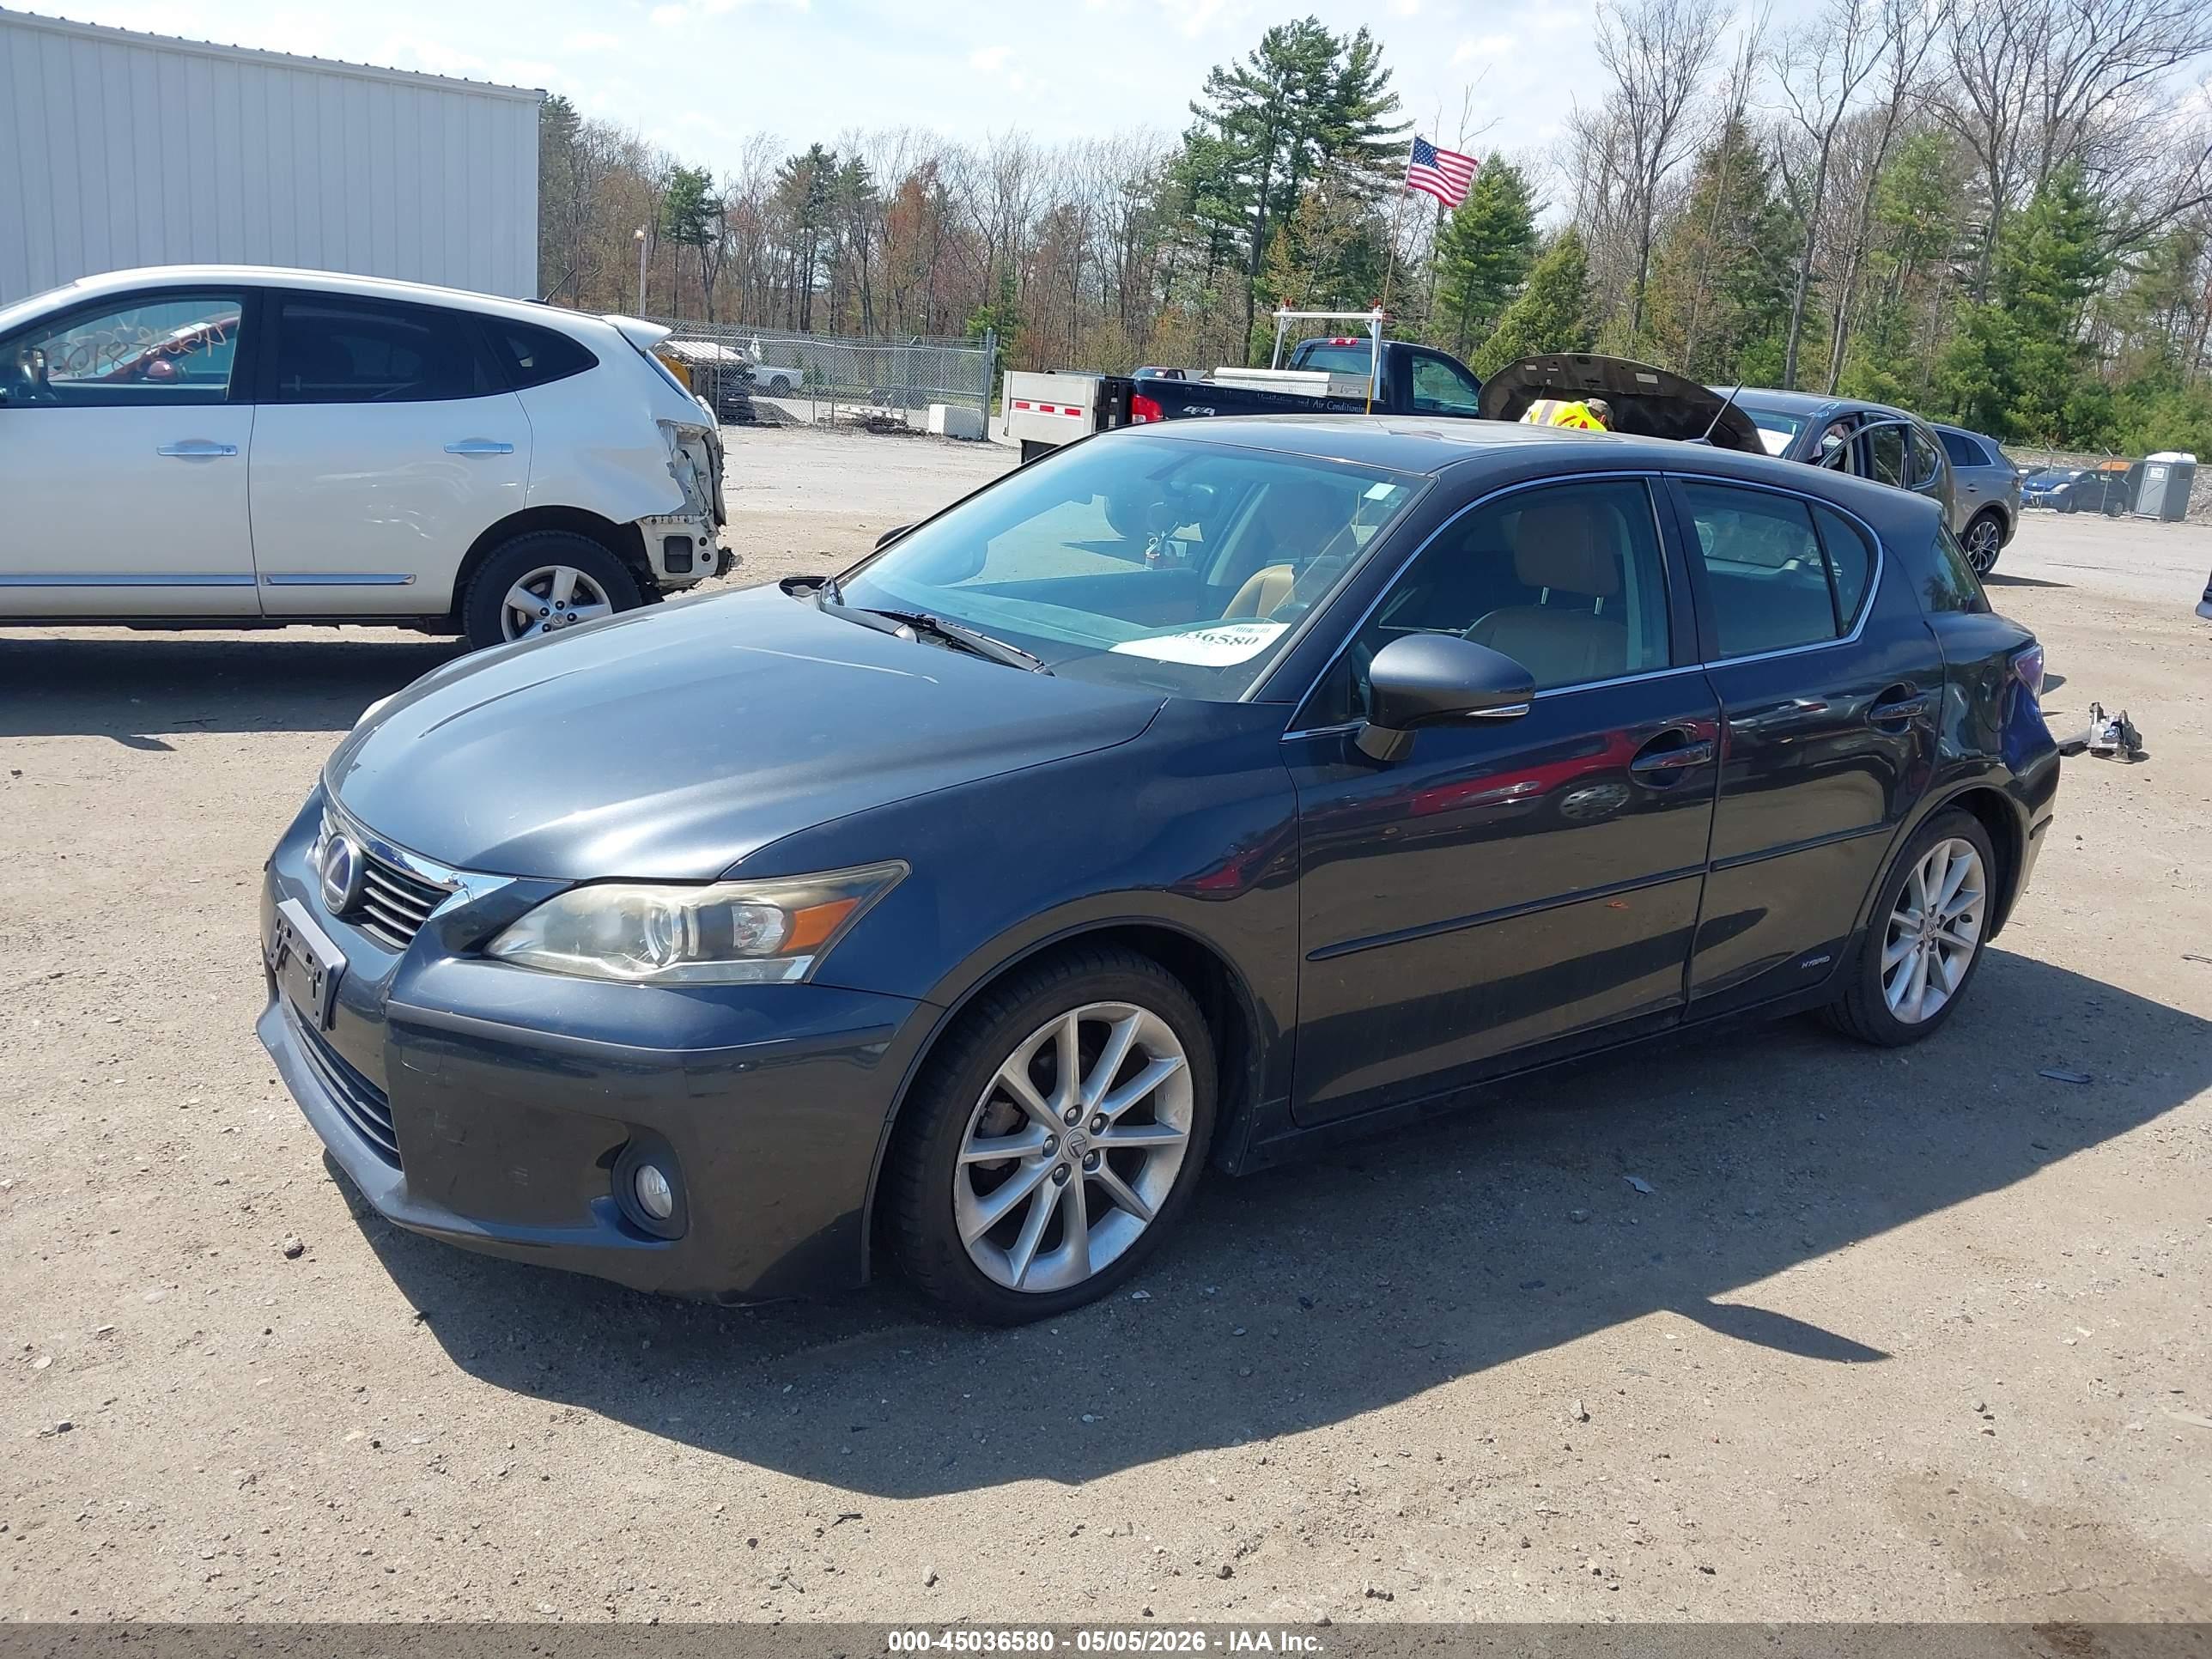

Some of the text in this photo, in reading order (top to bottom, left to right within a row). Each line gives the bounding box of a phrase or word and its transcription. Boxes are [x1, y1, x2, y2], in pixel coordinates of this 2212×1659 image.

[1312, 399, 1325, 410] Air
[1327, 400, 1365, 414] Conditionin
[1801, 956, 1830, 969] HYBRID
